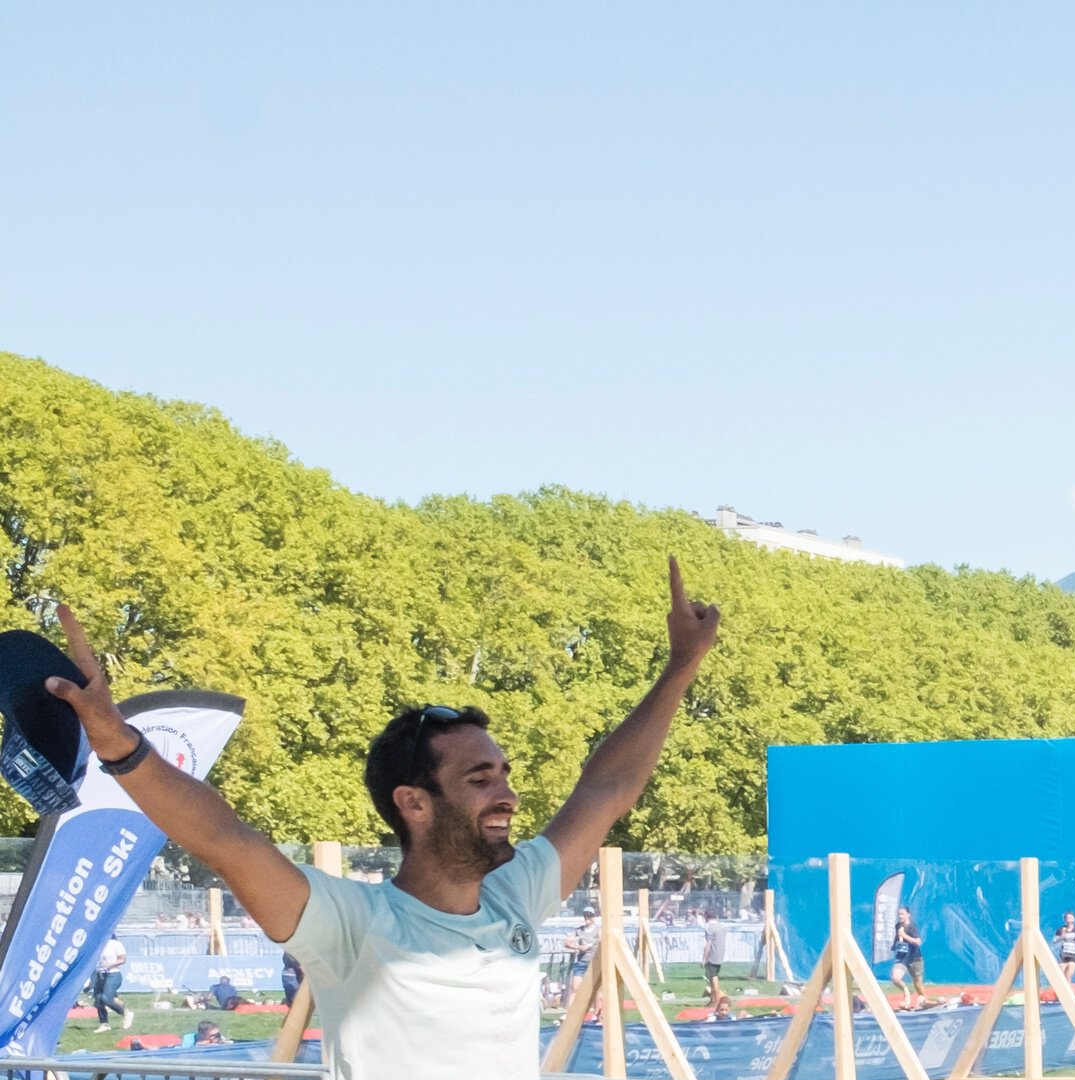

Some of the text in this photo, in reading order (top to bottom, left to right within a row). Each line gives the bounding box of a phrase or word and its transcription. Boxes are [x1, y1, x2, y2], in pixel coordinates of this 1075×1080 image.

[9, 857, 93, 1018] Fédération
[85, 884, 109, 921] de
[103, 828, 138, 878] Ski
